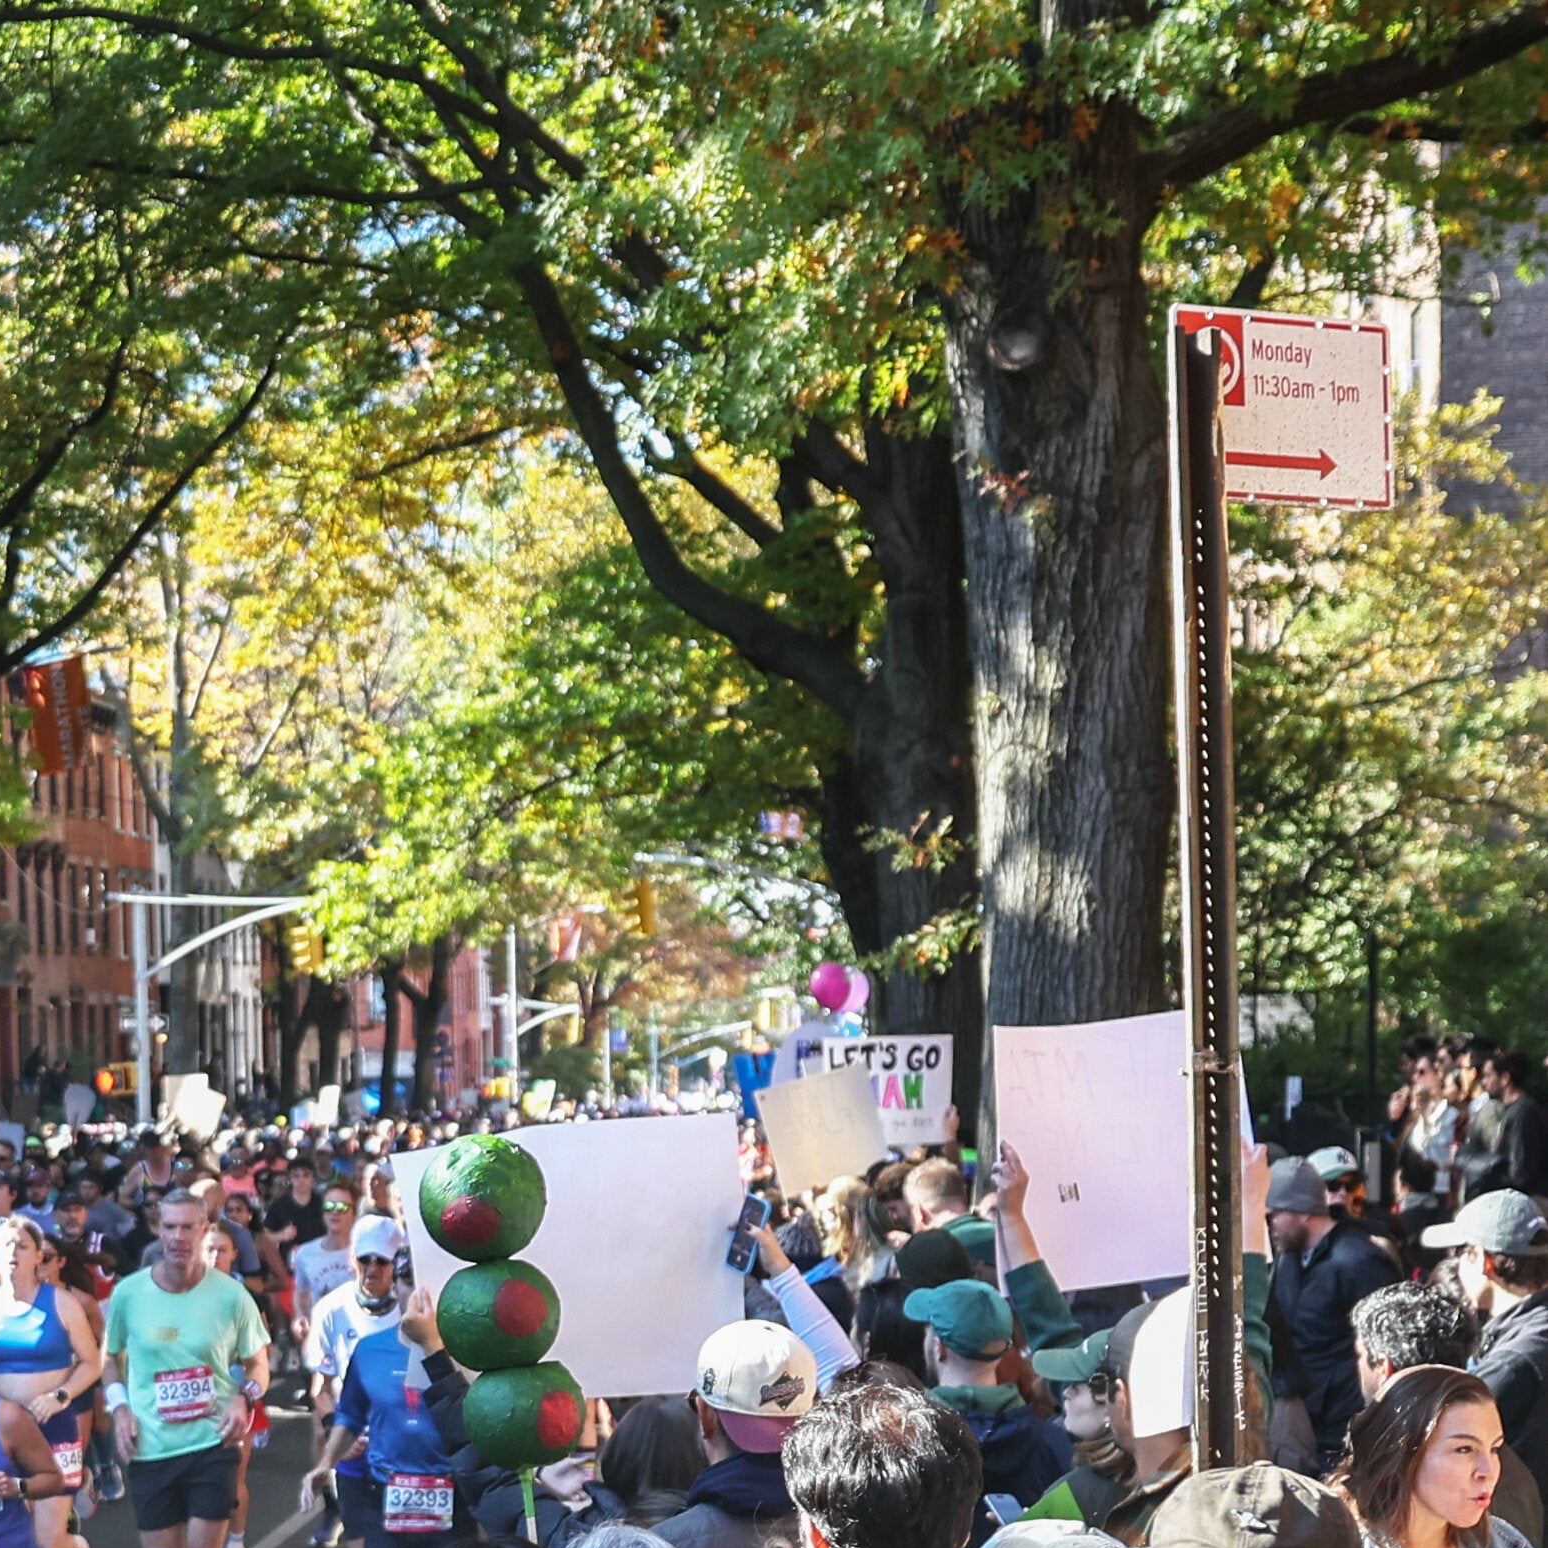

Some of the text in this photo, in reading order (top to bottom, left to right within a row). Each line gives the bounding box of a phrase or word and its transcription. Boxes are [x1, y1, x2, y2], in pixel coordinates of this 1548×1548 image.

[1251, 338, 1313, 369] Monday
[1253, 374, 1315, 400] 11:30am
[1331, 380, 1361, 406] 1pm
[828, 1042, 898, 1071] LET'S
[906, 1044, 942, 1071] GO
[159, 1378, 212, 1401] 32394
[390, 1488, 450, 1508] 32393
